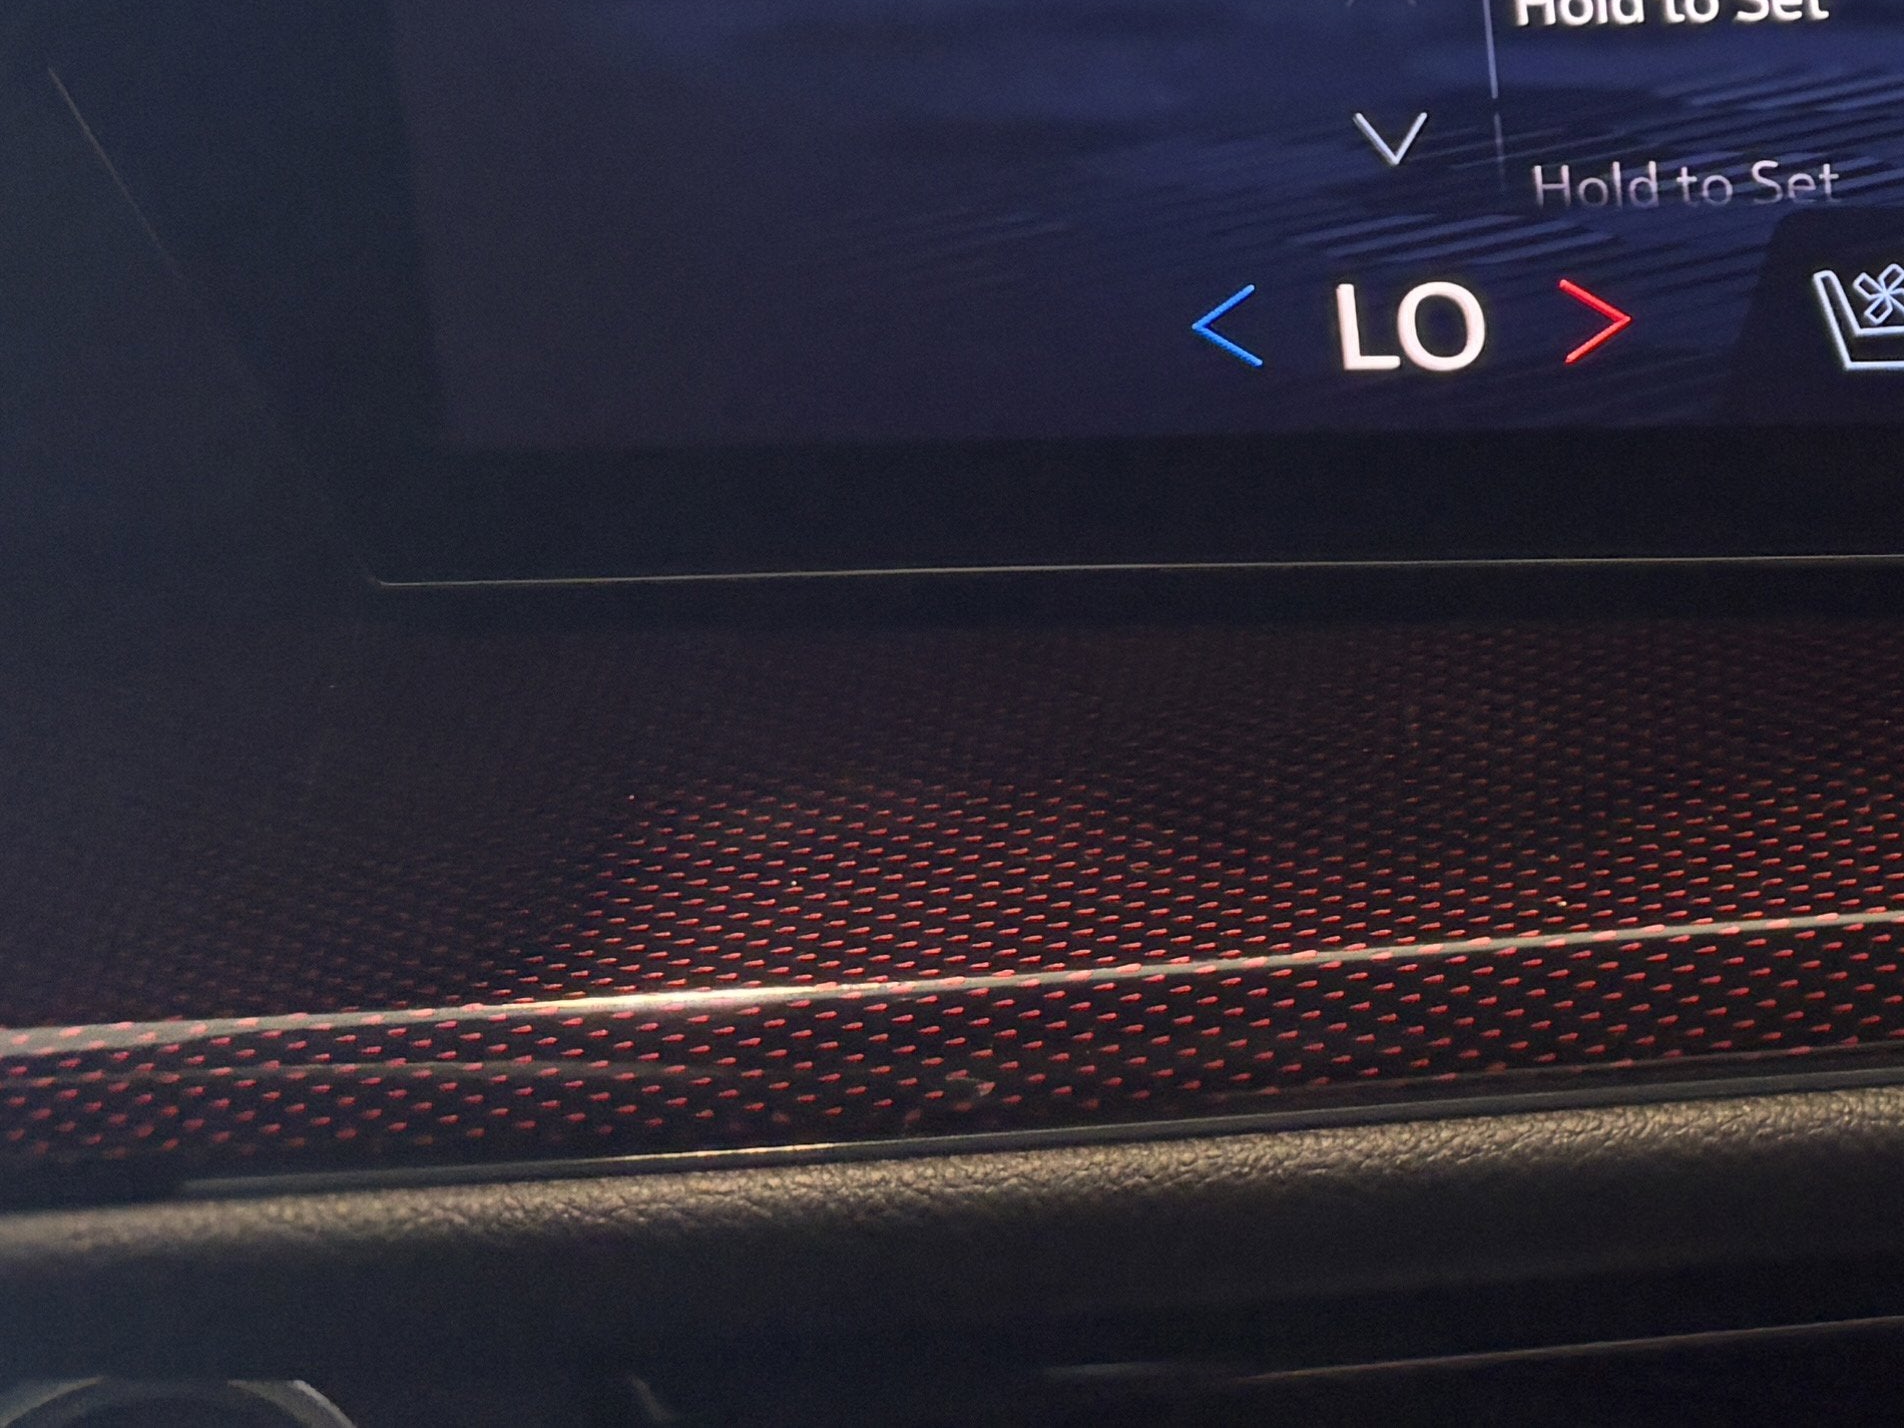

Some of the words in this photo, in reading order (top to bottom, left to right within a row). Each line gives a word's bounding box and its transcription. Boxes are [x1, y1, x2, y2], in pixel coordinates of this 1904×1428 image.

[1533, 160, 1659, 208] Hold
[1675, 164, 1734, 206] to
[1750, 159, 1840, 204] Set
[1336, 281, 1486, 372] LO
